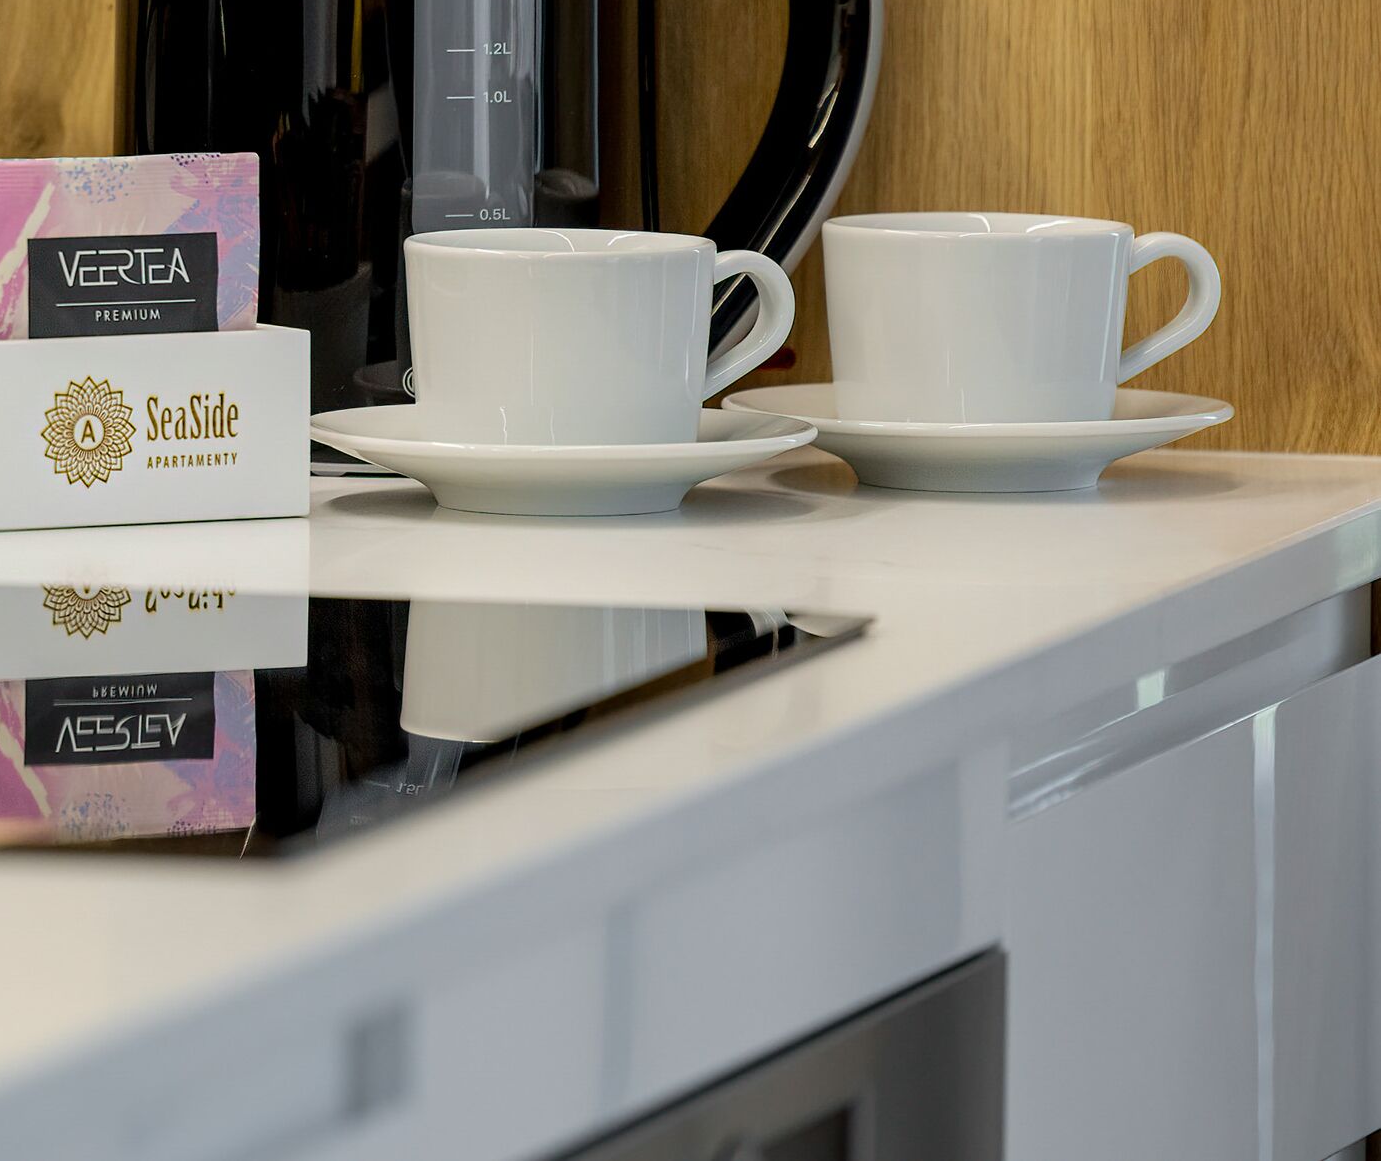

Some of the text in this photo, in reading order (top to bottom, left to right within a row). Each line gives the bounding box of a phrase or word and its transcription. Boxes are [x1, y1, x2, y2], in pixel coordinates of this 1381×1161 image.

[482, 42, 512, 56] 1.2L
[482, 90, 512, 104] 1.0L
[479, 208, 511, 222] 0.5L
[95, 308, 161, 322] PREMIUM
[146, 392, 239, 442] SeaSide
[80, 419, 96, 444] A
[146, 452, 238, 469] APARTAMENTY
